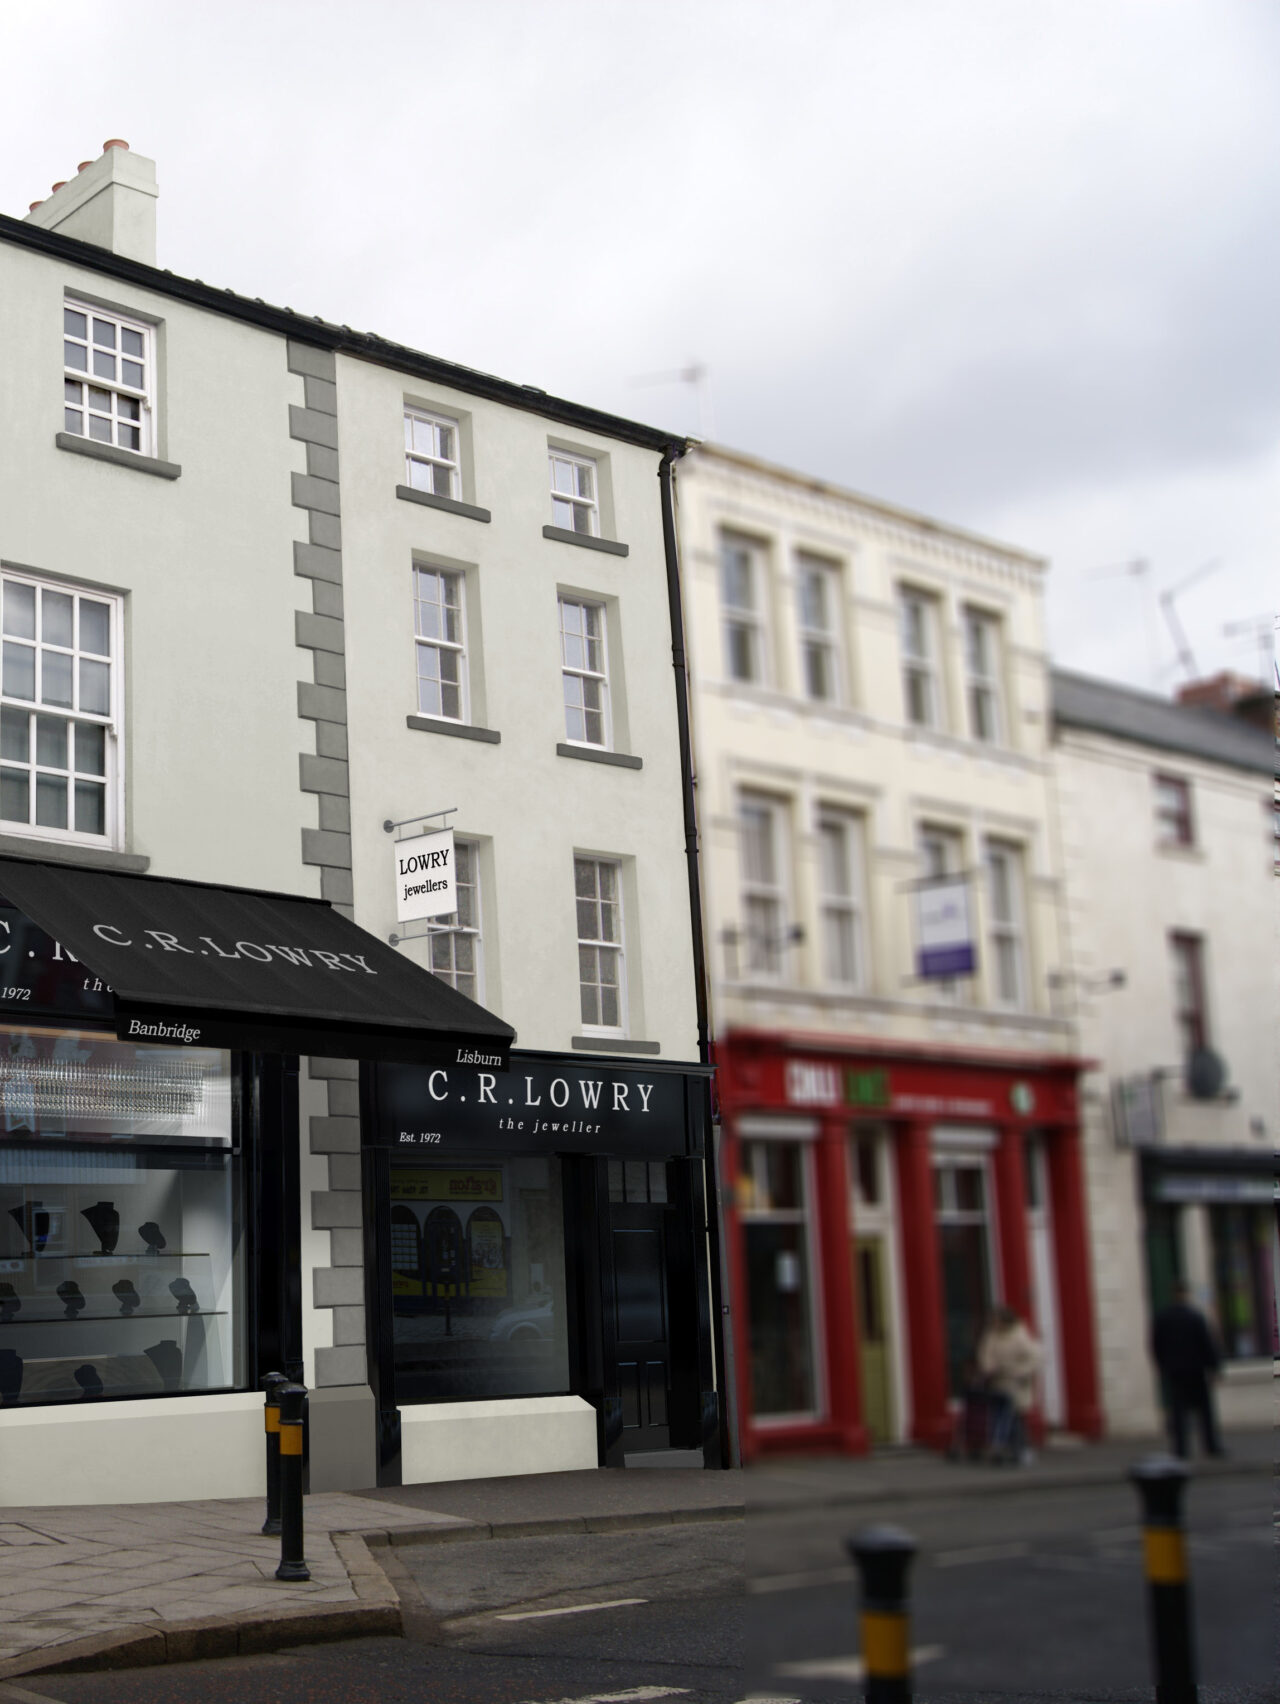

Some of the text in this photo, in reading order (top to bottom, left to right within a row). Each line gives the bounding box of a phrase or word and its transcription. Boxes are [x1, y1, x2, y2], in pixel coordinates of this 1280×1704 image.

[399, 849, 450, 875] LOWRY
[403, 879, 448, 901] jewellers
[2, 986, 31, 1000] 1972
[128, 1020, 201, 1043] Banbridge
[456, 1049, 502, 1066] Lisburn
[499, 1118, 601, 1134] the jeweller
[399, 1132, 441, 1144] Est. 1972
